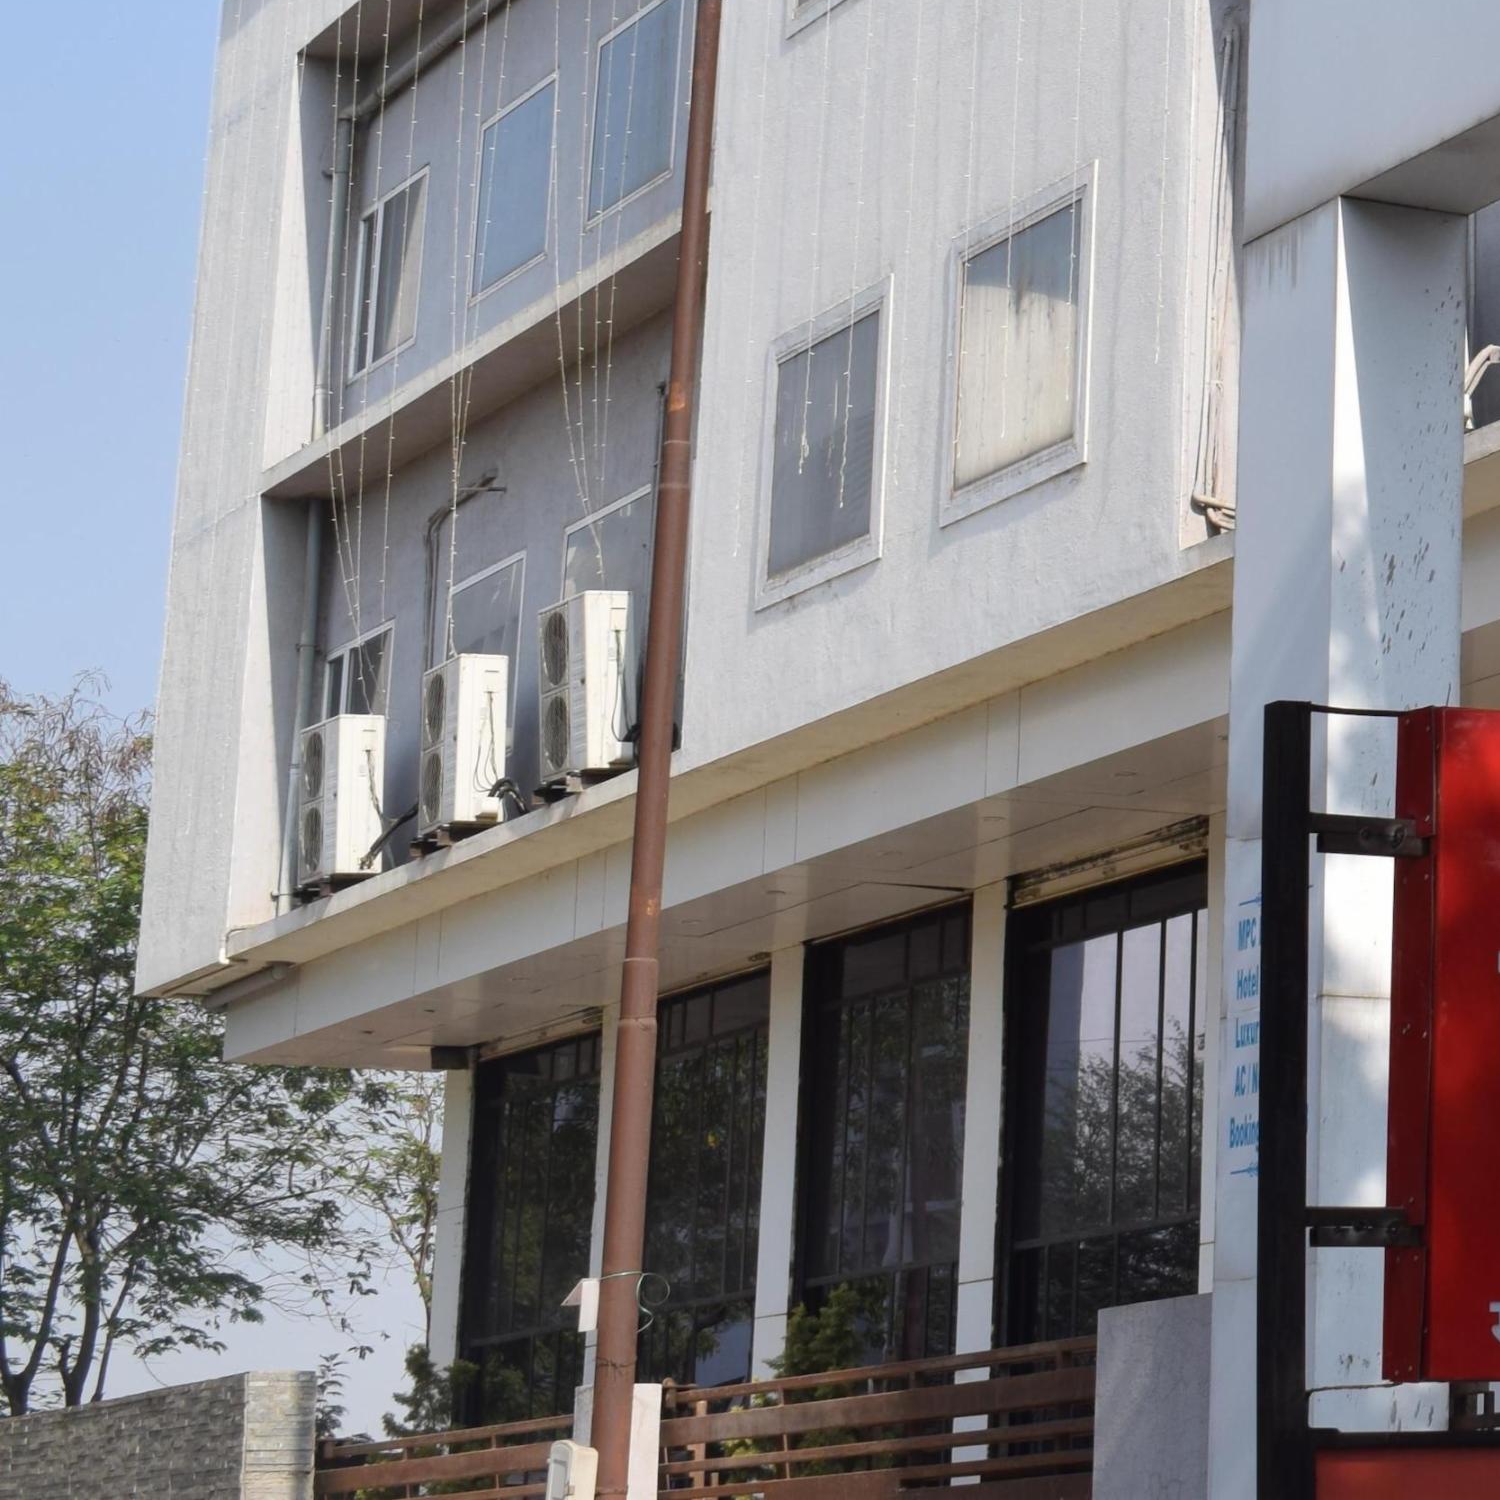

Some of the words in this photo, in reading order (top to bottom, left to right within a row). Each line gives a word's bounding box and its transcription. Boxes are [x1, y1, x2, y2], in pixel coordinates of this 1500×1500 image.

[1238, 918, 1257, 951] MPC
[1236, 964, 1259, 999] Hotel
[1234, 1065, 1246, 1096] AC
